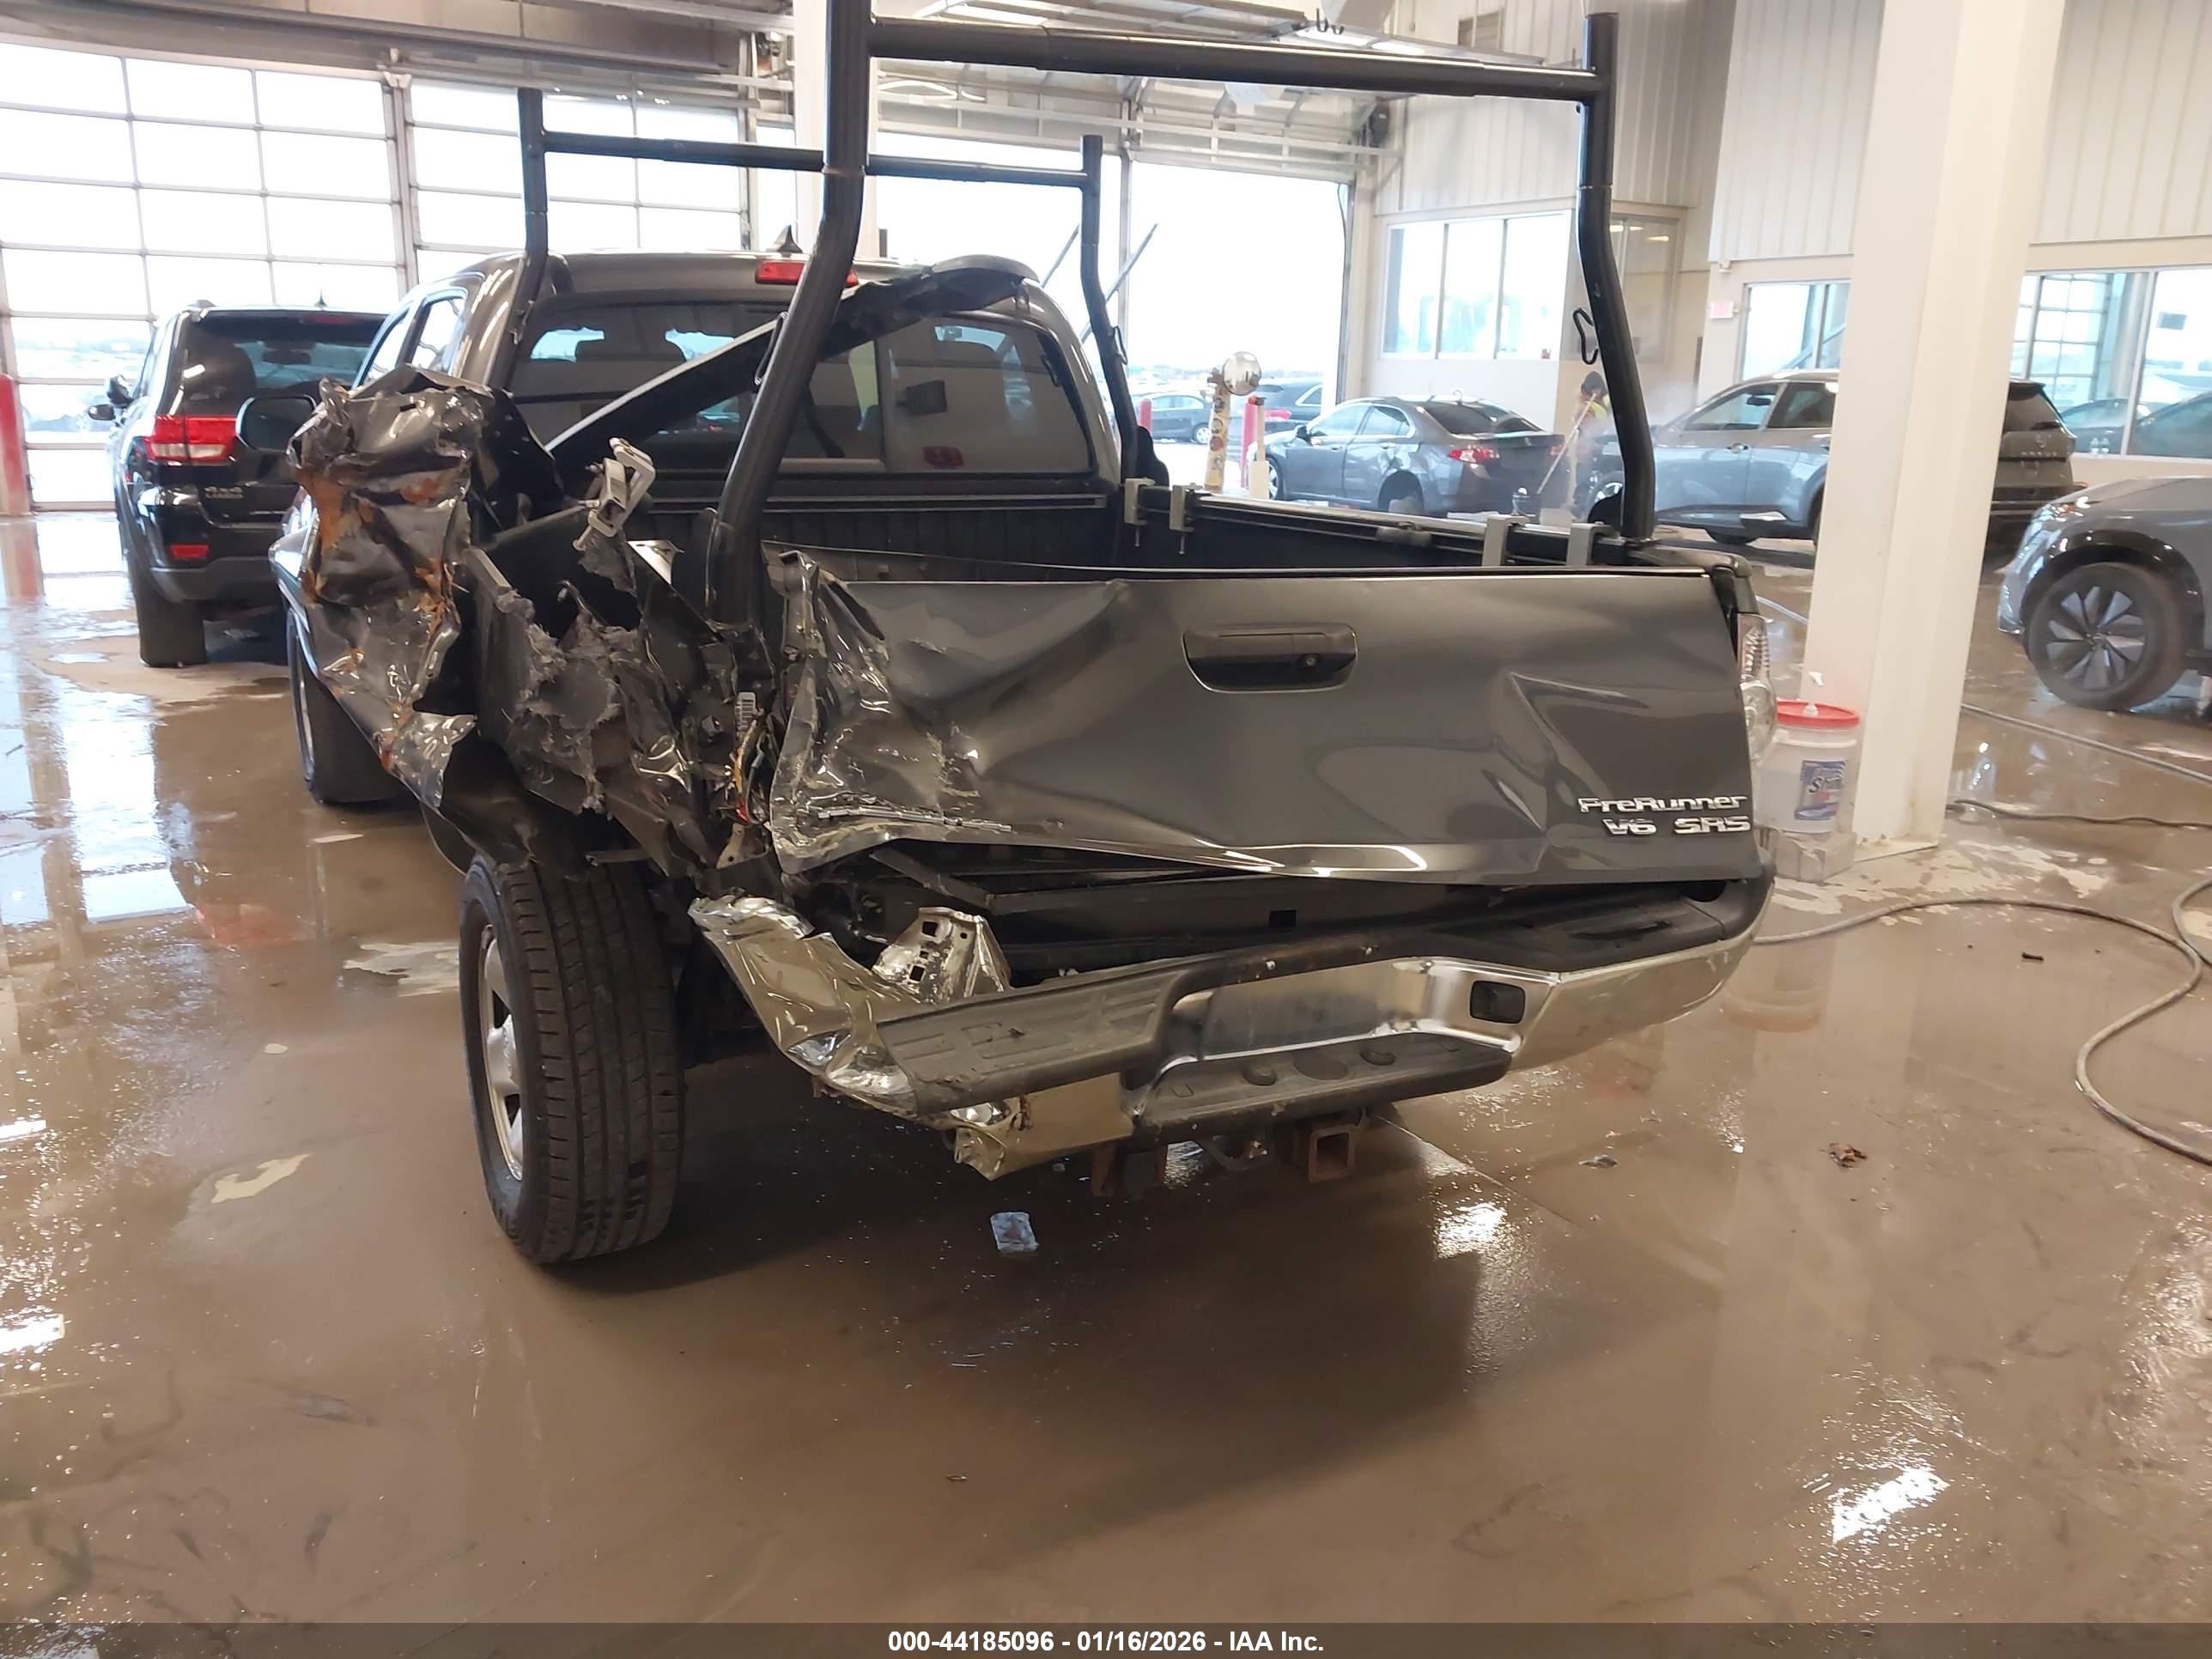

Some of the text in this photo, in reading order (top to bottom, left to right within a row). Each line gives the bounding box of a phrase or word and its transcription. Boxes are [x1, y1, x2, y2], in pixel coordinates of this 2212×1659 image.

[1578, 795, 1748, 813] PreRunner
[1602, 816, 1752, 836] V6 SR5
